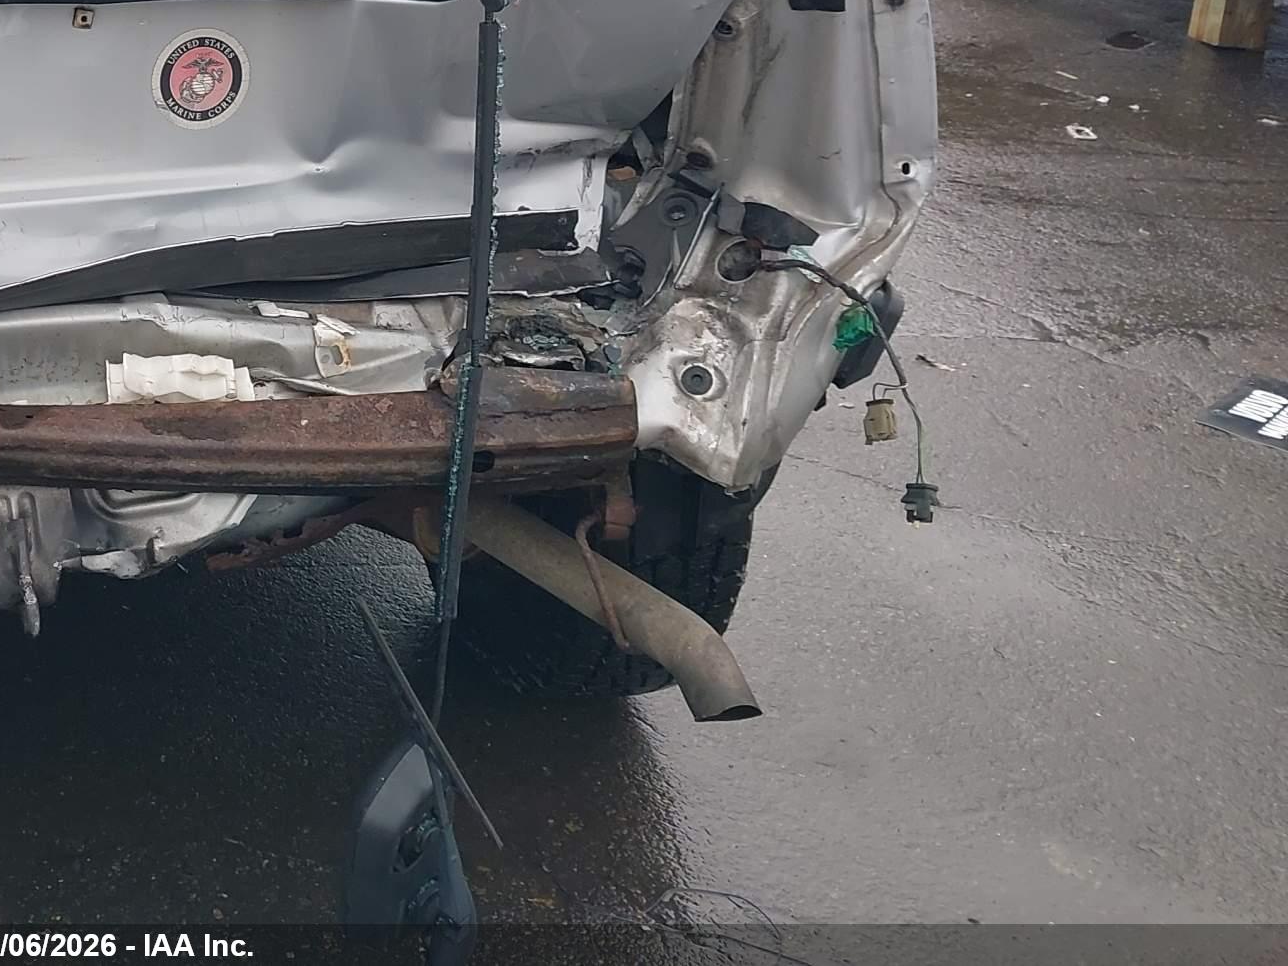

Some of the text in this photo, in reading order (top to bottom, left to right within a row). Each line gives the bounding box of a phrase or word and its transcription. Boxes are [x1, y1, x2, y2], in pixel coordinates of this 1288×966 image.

[167, 38, 235, 65] UNITED STATES
[166, 91, 236, 120] MARINE CORPS
